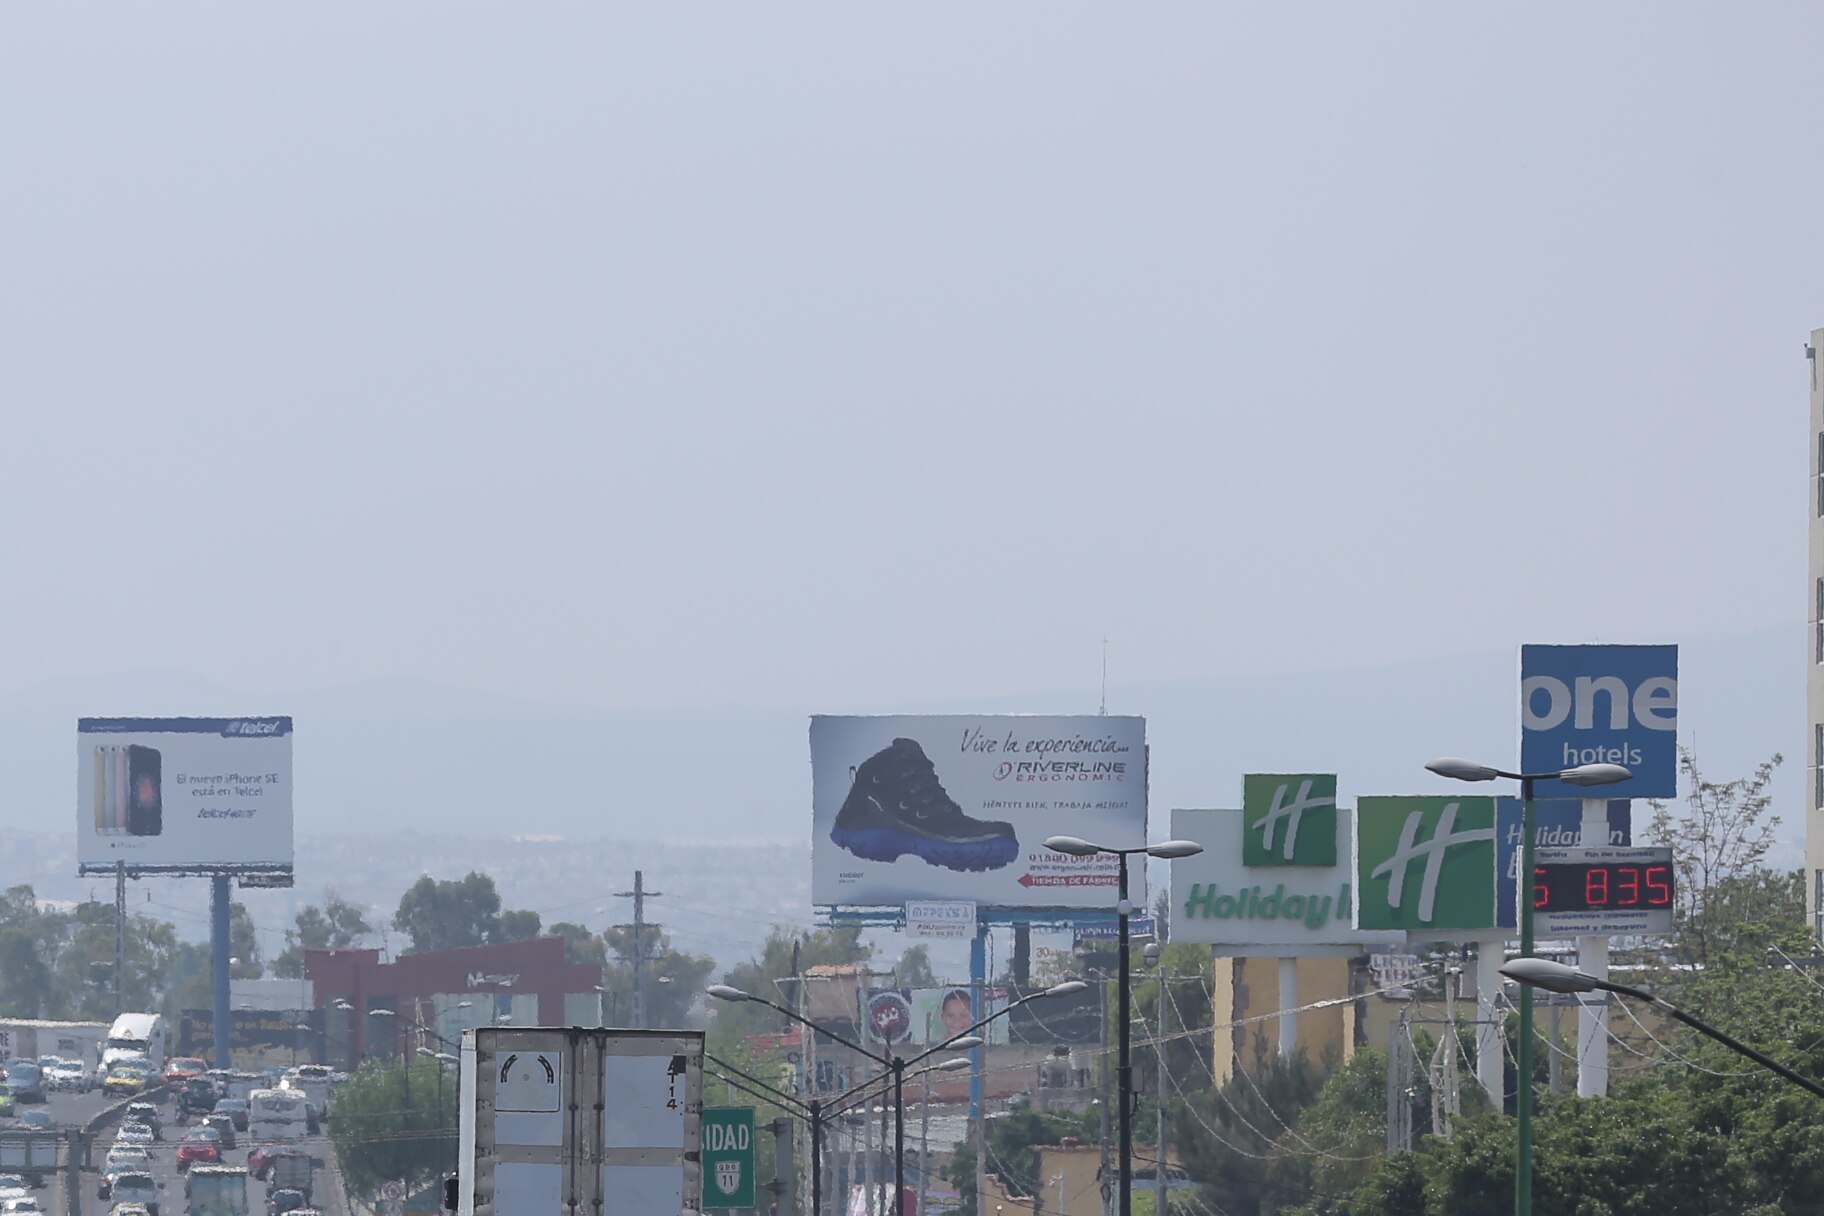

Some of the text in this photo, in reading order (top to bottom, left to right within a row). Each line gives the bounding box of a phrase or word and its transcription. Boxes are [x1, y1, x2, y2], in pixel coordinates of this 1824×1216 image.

[1521, 675, 1678, 732] one
[961, 726, 998, 753] Vive
[1004, 730, 1020, 753] la
[1562, 741, 1643, 766] hotels
[1016, 761, 1127, 774] RIVERLINE
[1016, 774, 1124, 782] ERGONOMIC
[1585, 867, 1670, 905] 835
[1184, 882, 1336, 930] Holiday
[701, 1124, 749, 1151] IDAD
